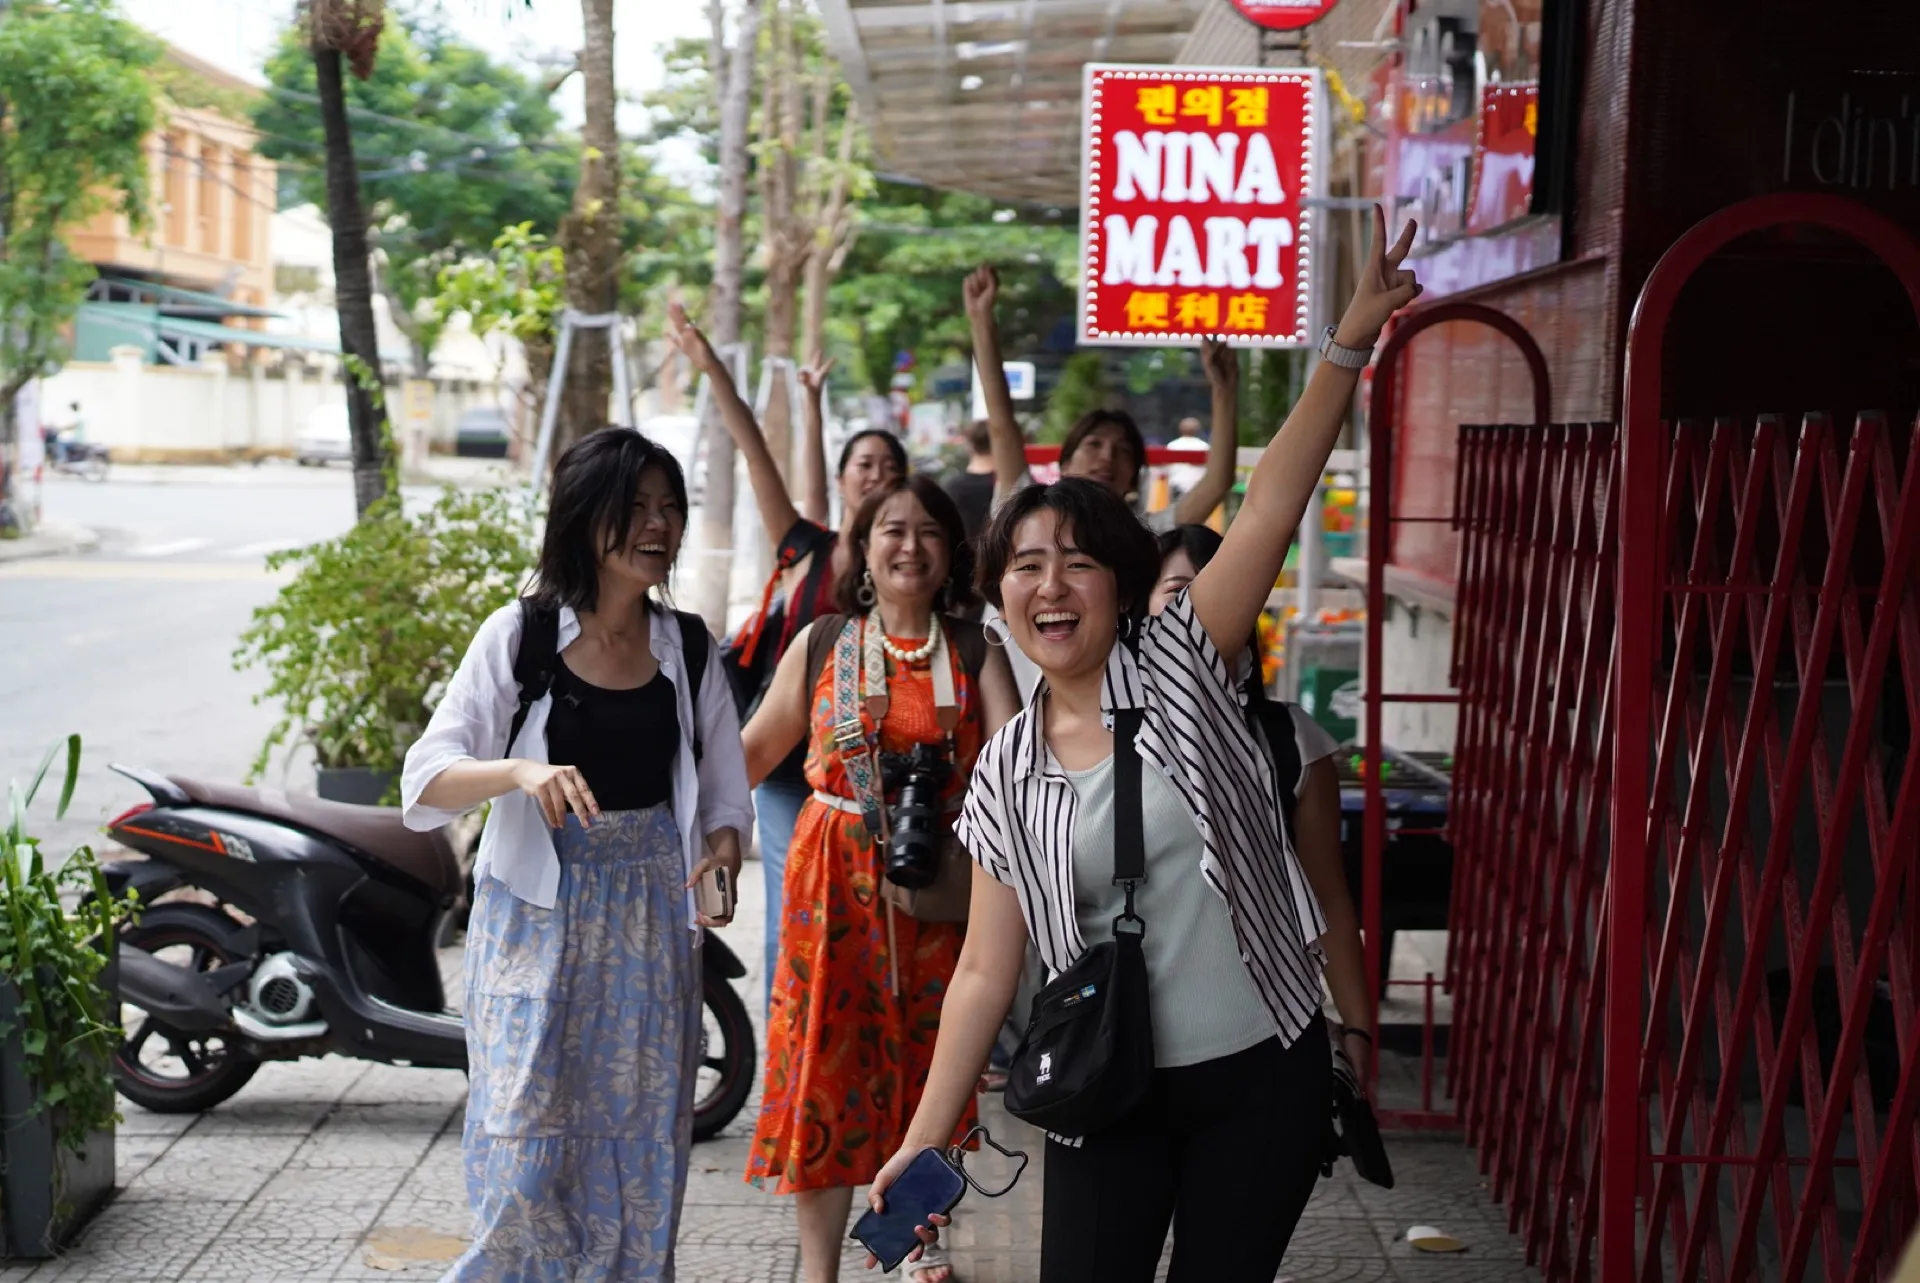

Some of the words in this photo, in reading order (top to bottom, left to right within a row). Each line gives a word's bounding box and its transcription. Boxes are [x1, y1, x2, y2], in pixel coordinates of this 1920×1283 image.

[1135, 83, 1269, 127] 편의점
[1112, 130, 1286, 205] NINA
[1102, 213, 1293, 290] MART
[1124, 290, 1270, 330] 便利店
